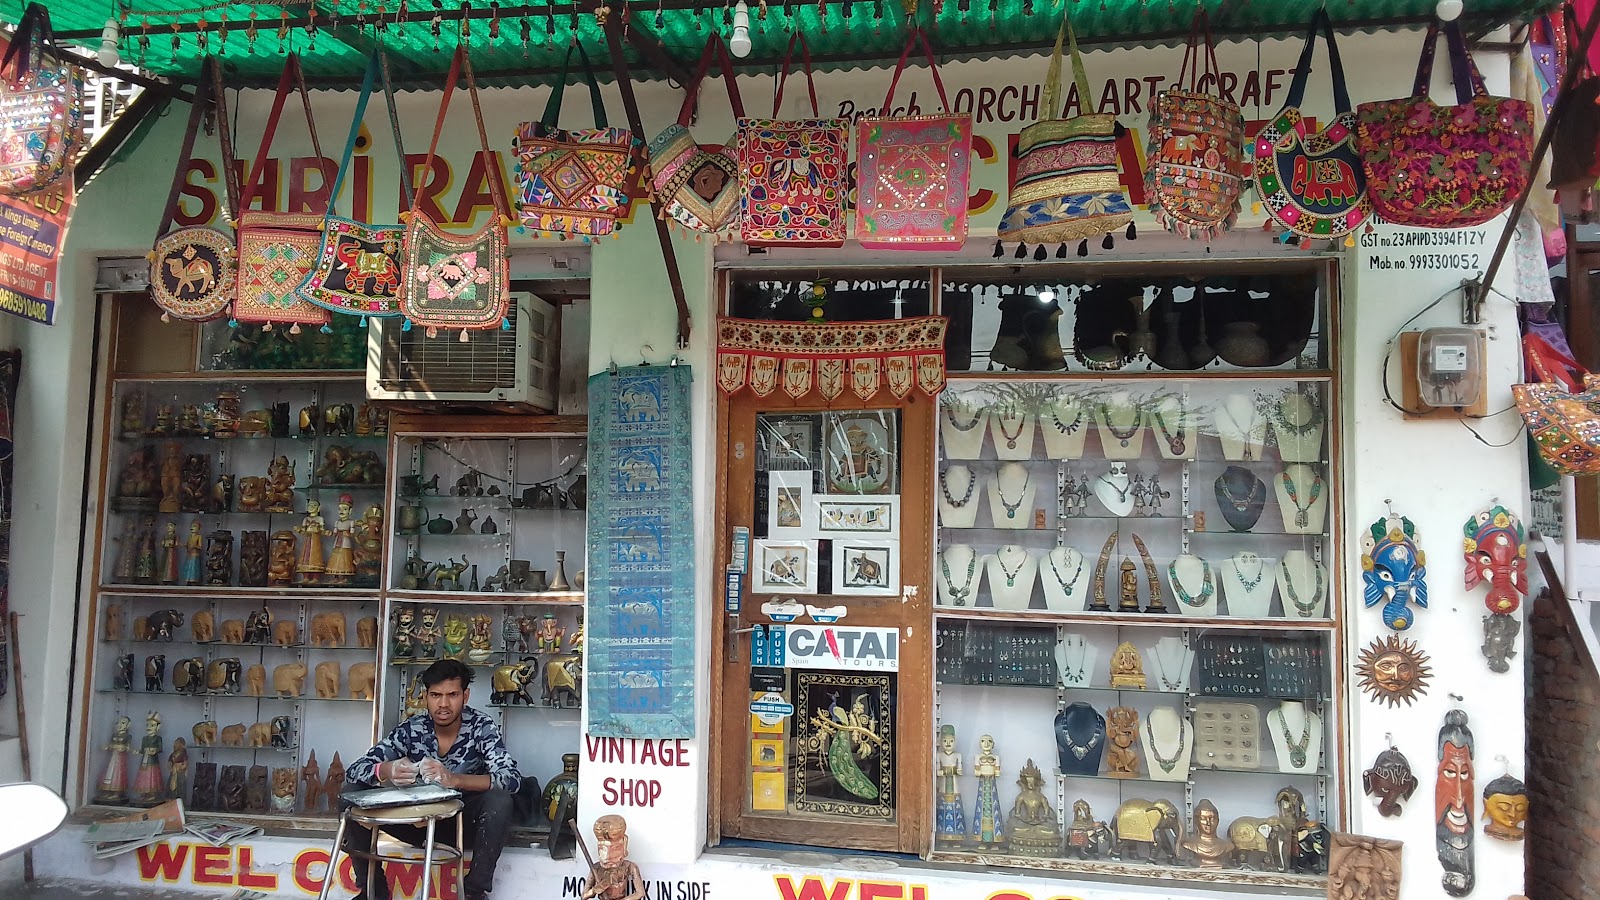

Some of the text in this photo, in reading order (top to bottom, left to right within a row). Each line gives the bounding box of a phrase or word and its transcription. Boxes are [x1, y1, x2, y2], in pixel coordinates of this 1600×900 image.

[953, 81, 1082, 124] ORCHA
[1099, 76, 1165, 114] ART
[1361, 233, 1379, 247] GST
[25, 261, 48, 278] AGENT
[1409, 253, 1479, 270] 9993301052
[774, 632, 782, 665] PUSH
[788, 628, 897, 660] CATAI
[585, 733, 690, 767] VINTAGE
[602, 777, 662, 808] SHOP
